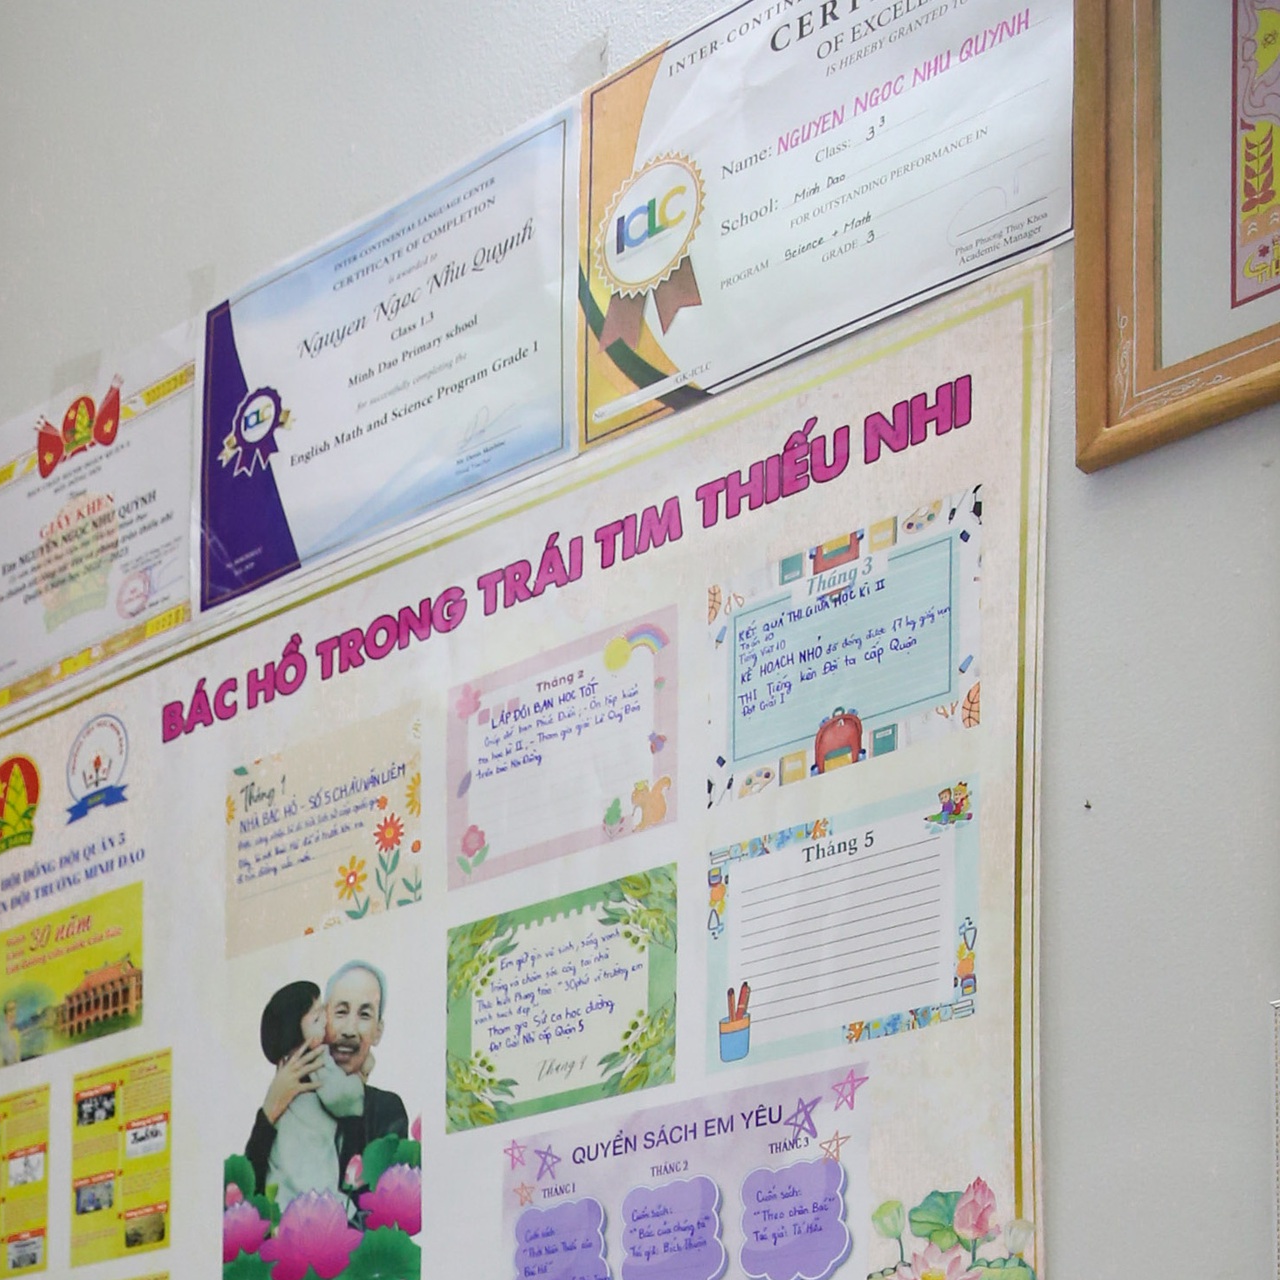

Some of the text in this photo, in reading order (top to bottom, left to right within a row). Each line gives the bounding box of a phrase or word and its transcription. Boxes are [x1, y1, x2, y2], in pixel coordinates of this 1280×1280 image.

[817, 33, 844, 60] OF
[839, 4, 948, 71] HEREBY GRANTED
[777, 8, 1030, 155] NGUYEN NGOC NHU QUYNH
[721, 146, 773, 180] Name:
[815, 138, 852, 164] Class:
[790, 126, 989, 230] FOR OUTSTANDING PERFORMANCE IN
[792, 172, 846, 204] Minh Dao
[616, 185, 686, 255] ICLC
[721, 198, 779, 237] School:
[783, 212, 873, 262] Science Math
[866, 230, 876, 244] 3
[332, 196, 496, 292] CERTIFICATE COMPLETION
[471, 217, 535, 273] Quynh
[822, 238, 859, 263] GRADE
[958, 224, 1043, 266] Academic Manager
[720, 259, 770, 290] PROGRAM
[348, 314, 479, 389] Minh Dao Primary school
[390, 321, 416, 342] Class
[290, 347, 529, 468] English Math and Science Program Grade
[162, 375, 973, 743] BÁC HỒ TRONG TRÁI TIM THIẾU NHI
[807, 557, 872, 596] Tháng 3
[536, 673, 574, 692] Tháng
[802, 831, 874, 864] Tháng 5
[572, 1104, 783, 1165] QUYỂN SÁCH EM YÊU
